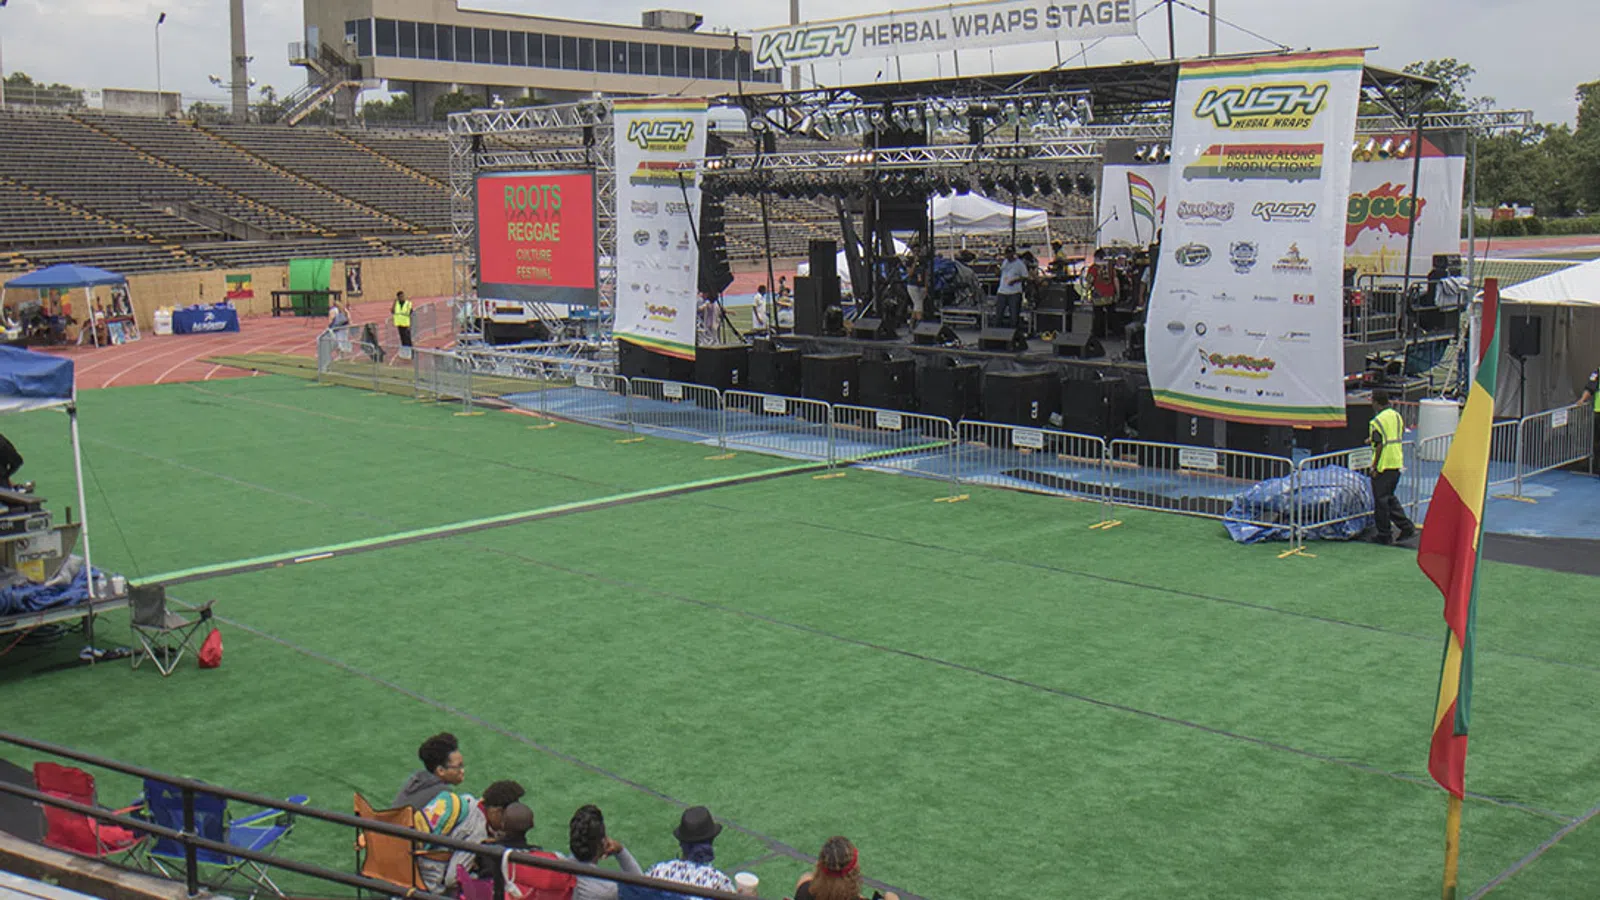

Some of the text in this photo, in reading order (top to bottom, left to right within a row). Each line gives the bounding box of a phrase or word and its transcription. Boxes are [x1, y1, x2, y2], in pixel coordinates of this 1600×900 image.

[756, 0, 1132, 67] KUSH HERBAL WRAPS STAGE
[1195, 83, 1328, 127] KUSH
[1233, 117, 1311, 129] HERBAL WRAPS
[628, 121, 694, 149] KUSH
[1227, 148, 1316, 160] ROLLING ALONG
[1226, 161, 1314, 173] PRODUCTIONS
[503, 184, 562, 210] ROOTS
[1251, 202, 1316, 222] KUSH
[507, 222, 561, 242] REGGAE
